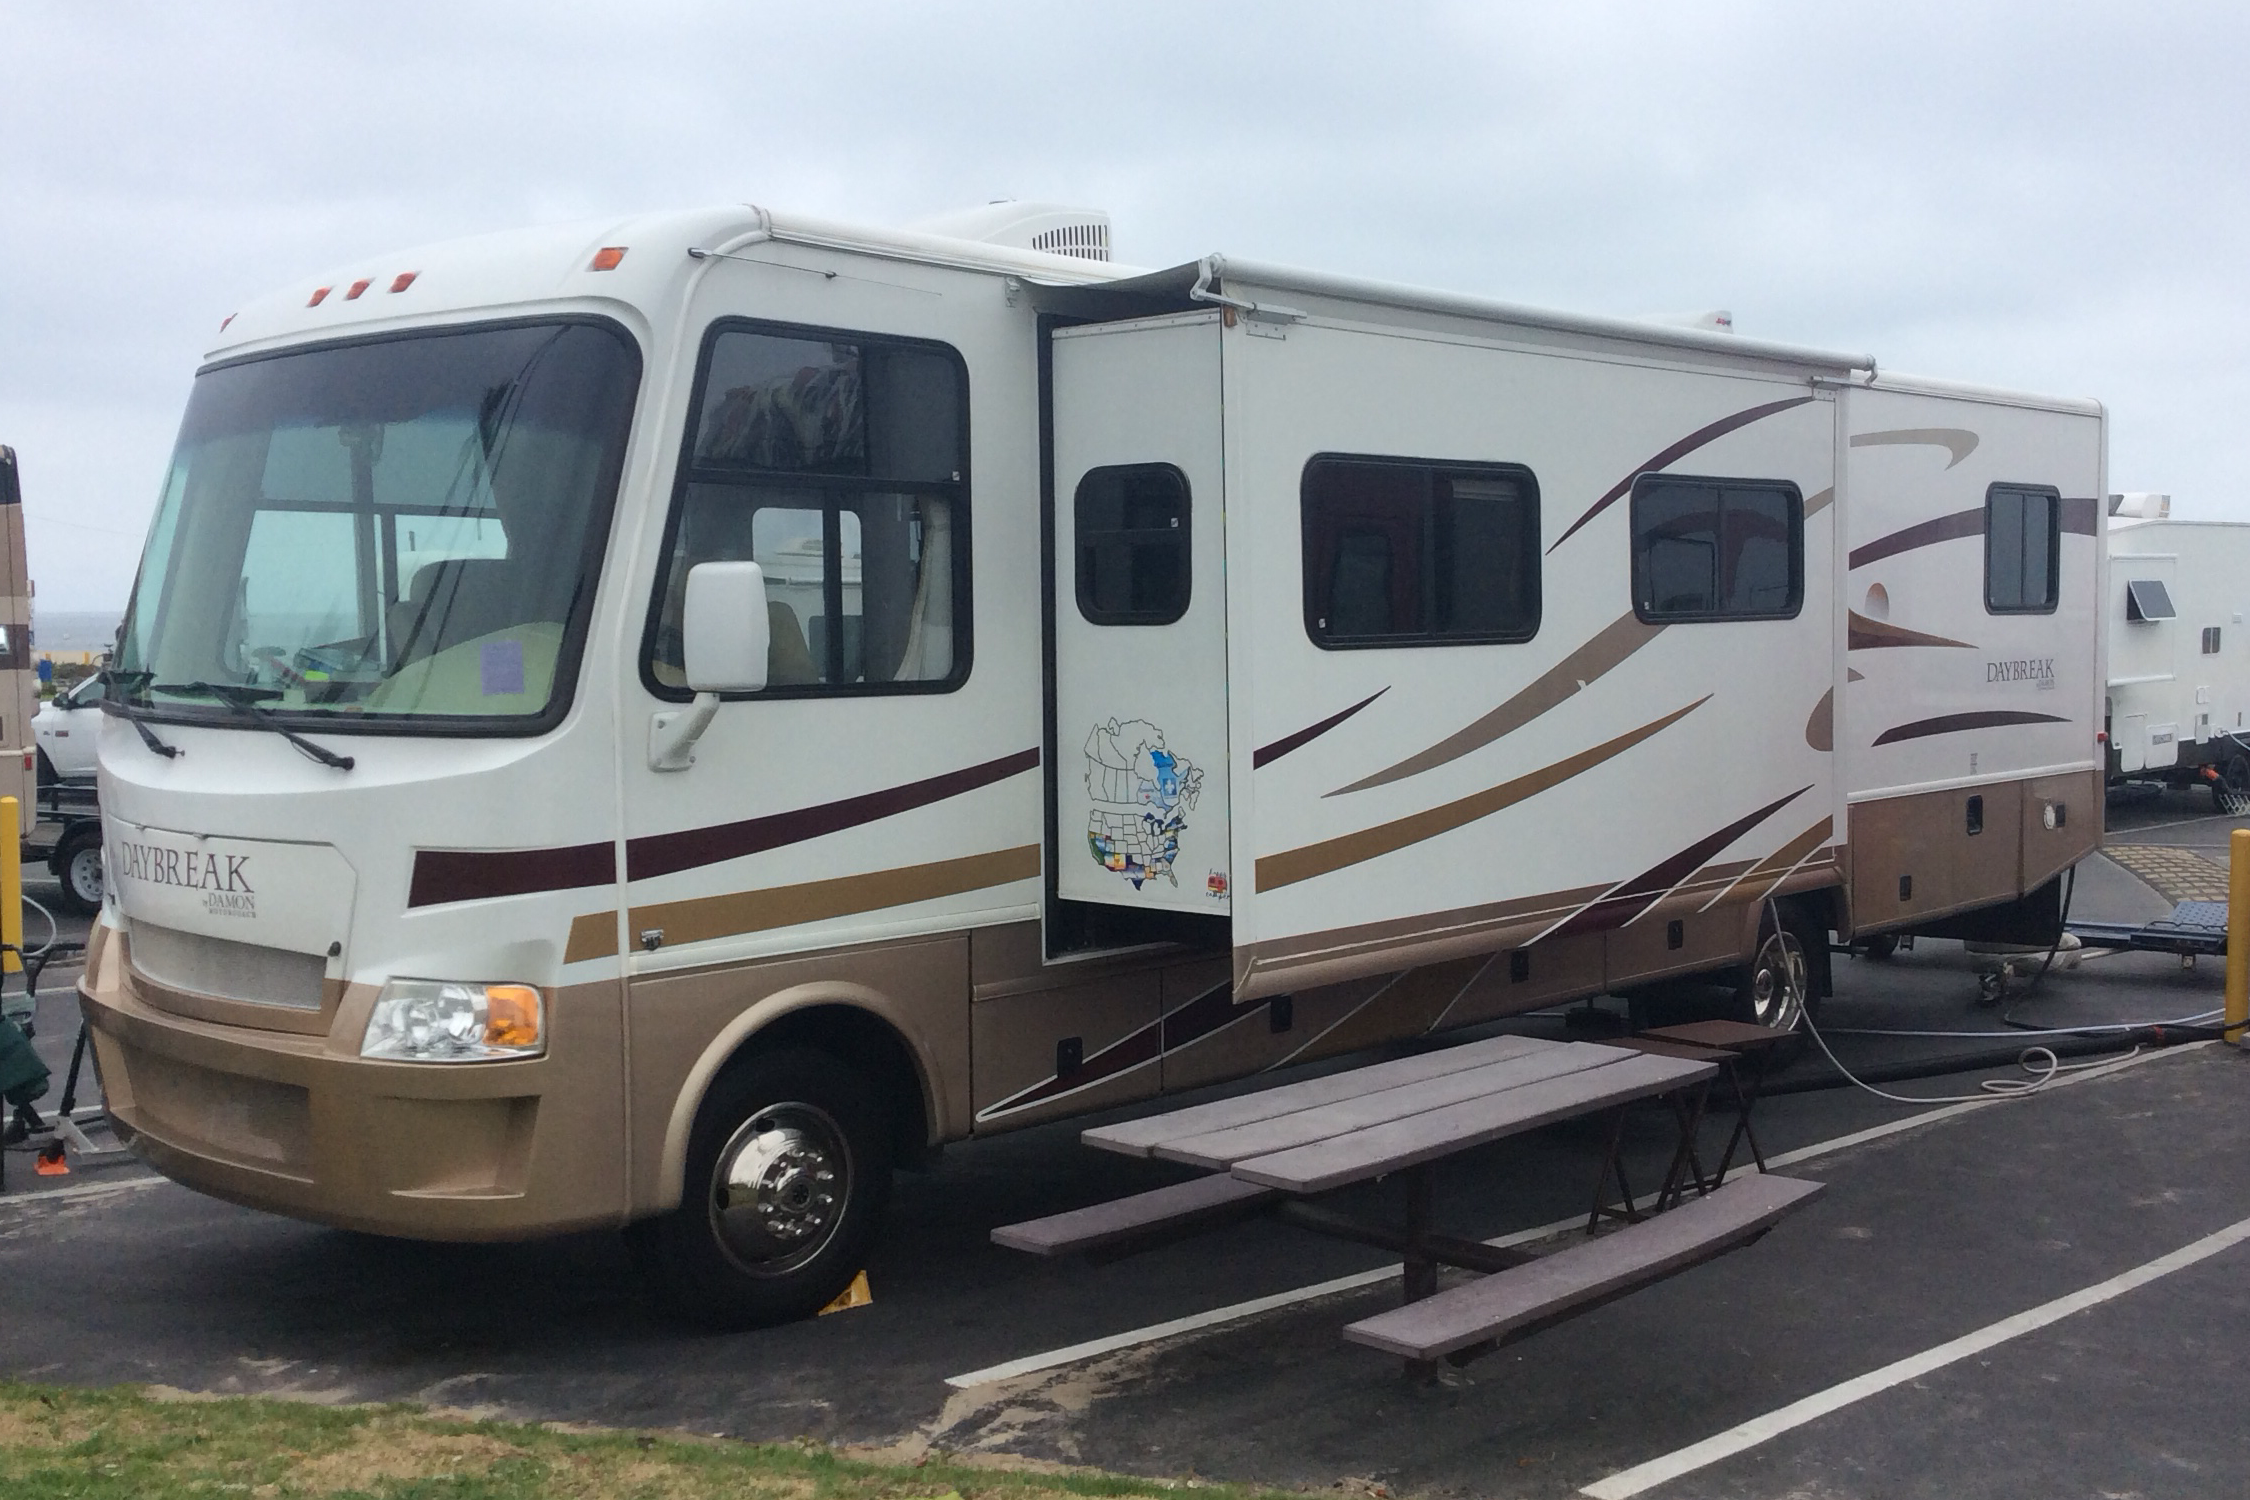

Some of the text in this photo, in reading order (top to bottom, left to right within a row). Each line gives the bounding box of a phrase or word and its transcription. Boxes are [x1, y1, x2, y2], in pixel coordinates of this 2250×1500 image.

[1986, 659, 2055, 682] DAYBREAK
[121, 841, 254, 893] DAYBREAK
[208, 892, 255, 910] DAMON
